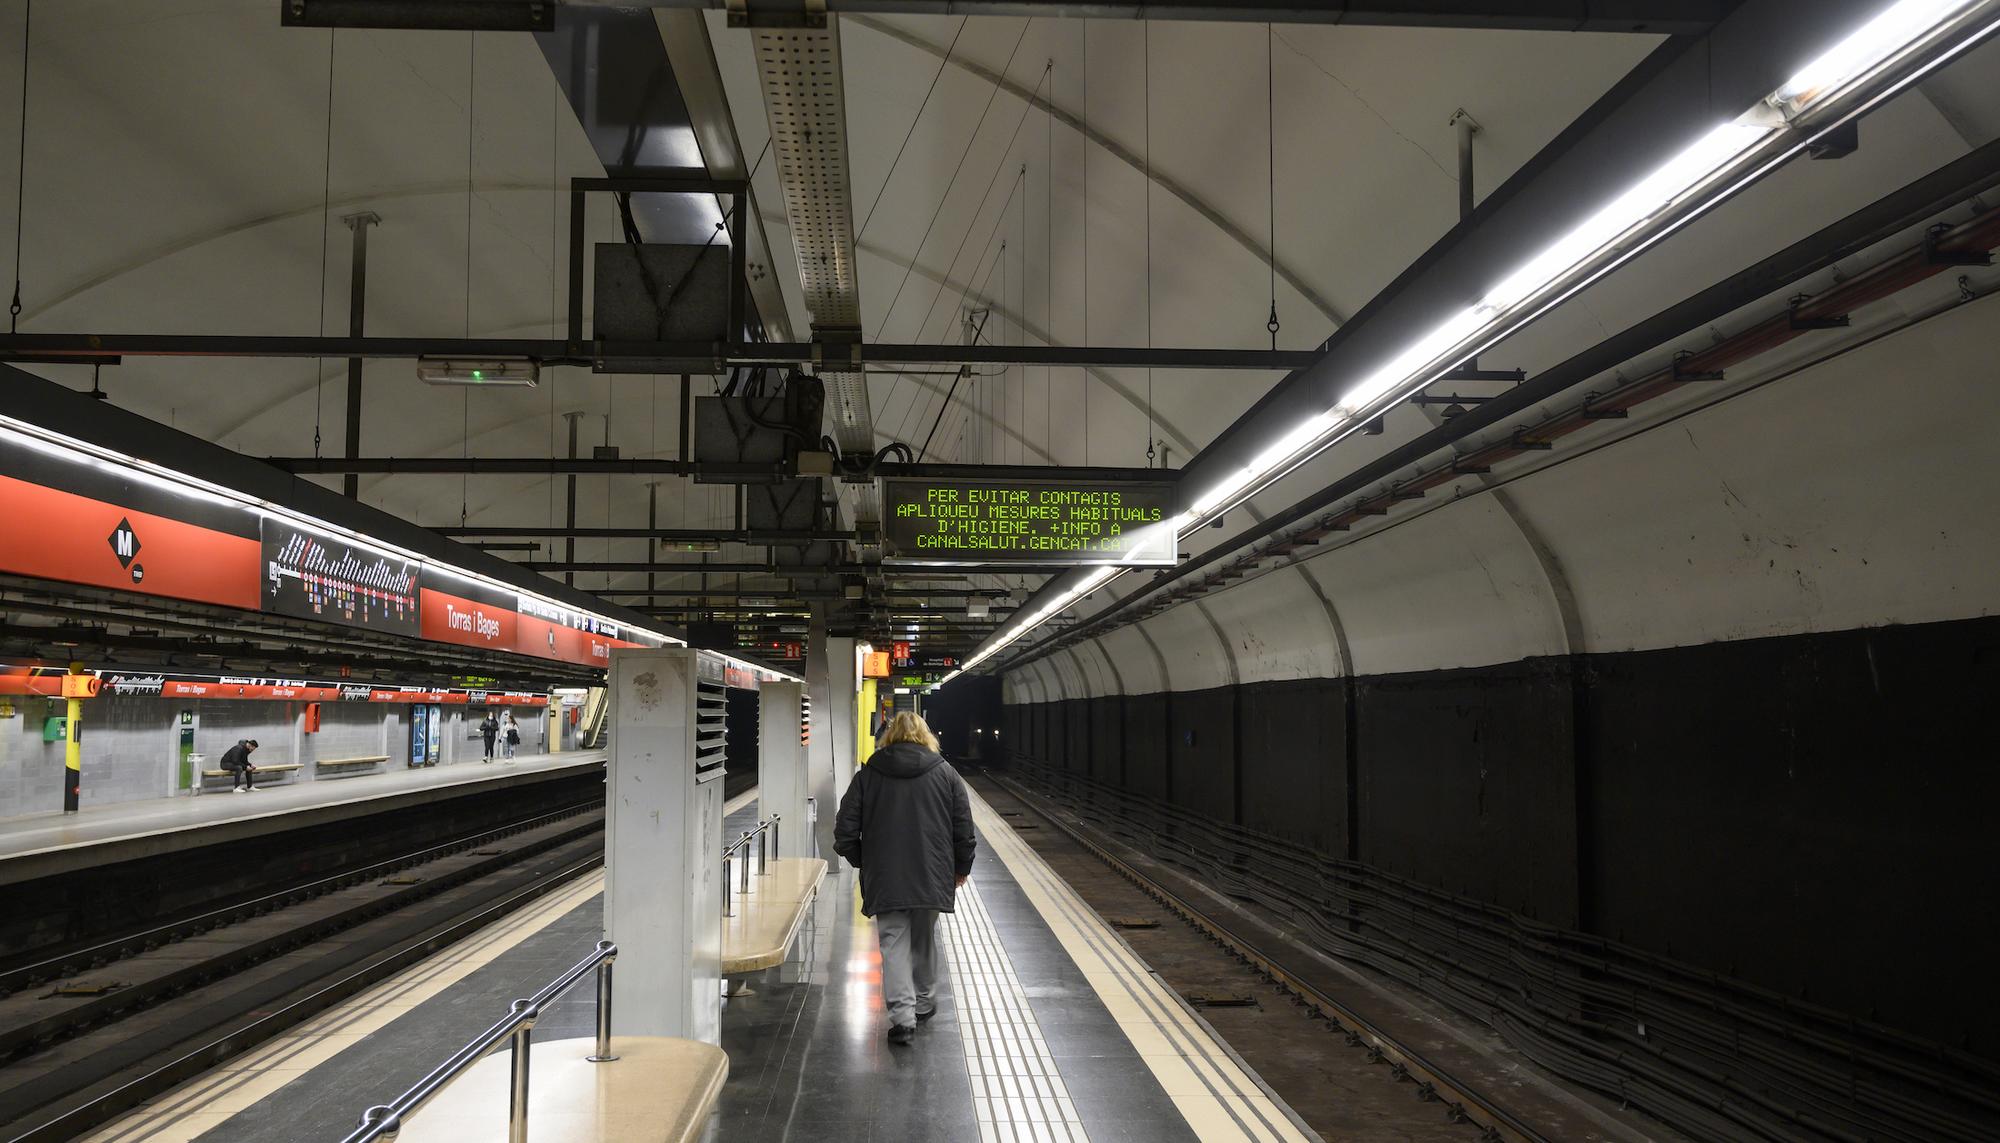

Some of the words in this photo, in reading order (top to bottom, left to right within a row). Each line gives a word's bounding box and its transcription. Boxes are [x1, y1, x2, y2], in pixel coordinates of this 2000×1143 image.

[928, 489, 958, 502] PER
[968, 489, 1029, 503] EVITAR
[1040, 491, 1121, 505] CONTAGIS
[897, 504, 978, 518] APLIQUEU
[989, 505, 1060, 520] MESURES
[1070, 507, 1161, 521] HABITUALS
[938, 519, 1036, 534] D'HIGIENE.
[1050, 522, 1101, 535] +INFO
[1111, 523, 1121, 535] A
[118, 529, 132, 557] M
[447, 604, 472, 631] Torras
[477, 611, 500, 640] Bages
[872, 654, 880, 675] SOS
